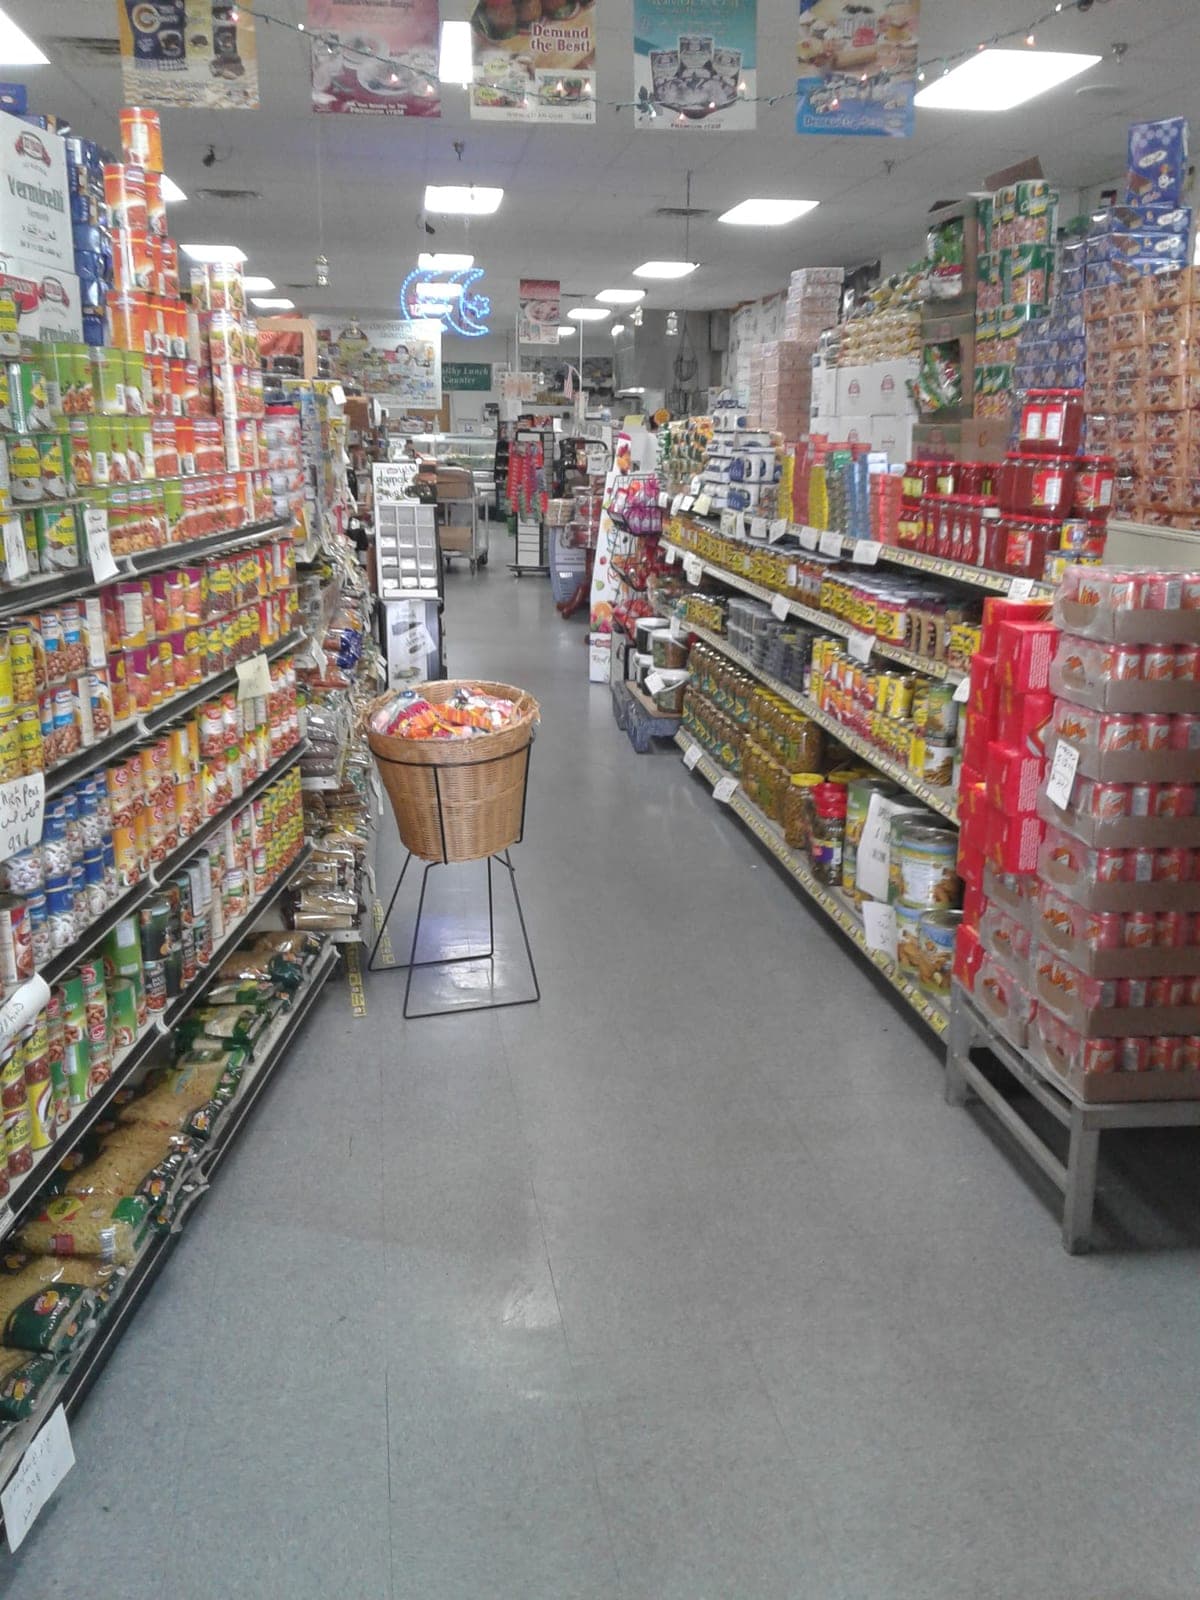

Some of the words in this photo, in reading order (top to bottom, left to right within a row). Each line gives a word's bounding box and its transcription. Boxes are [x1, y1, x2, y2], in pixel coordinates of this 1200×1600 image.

[532, 24, 590, 39] Demand
[531, 38, 553, 52] the
[557, 39, 590, 52] Best!
[7, 174, 65, 213] Vermicelli
